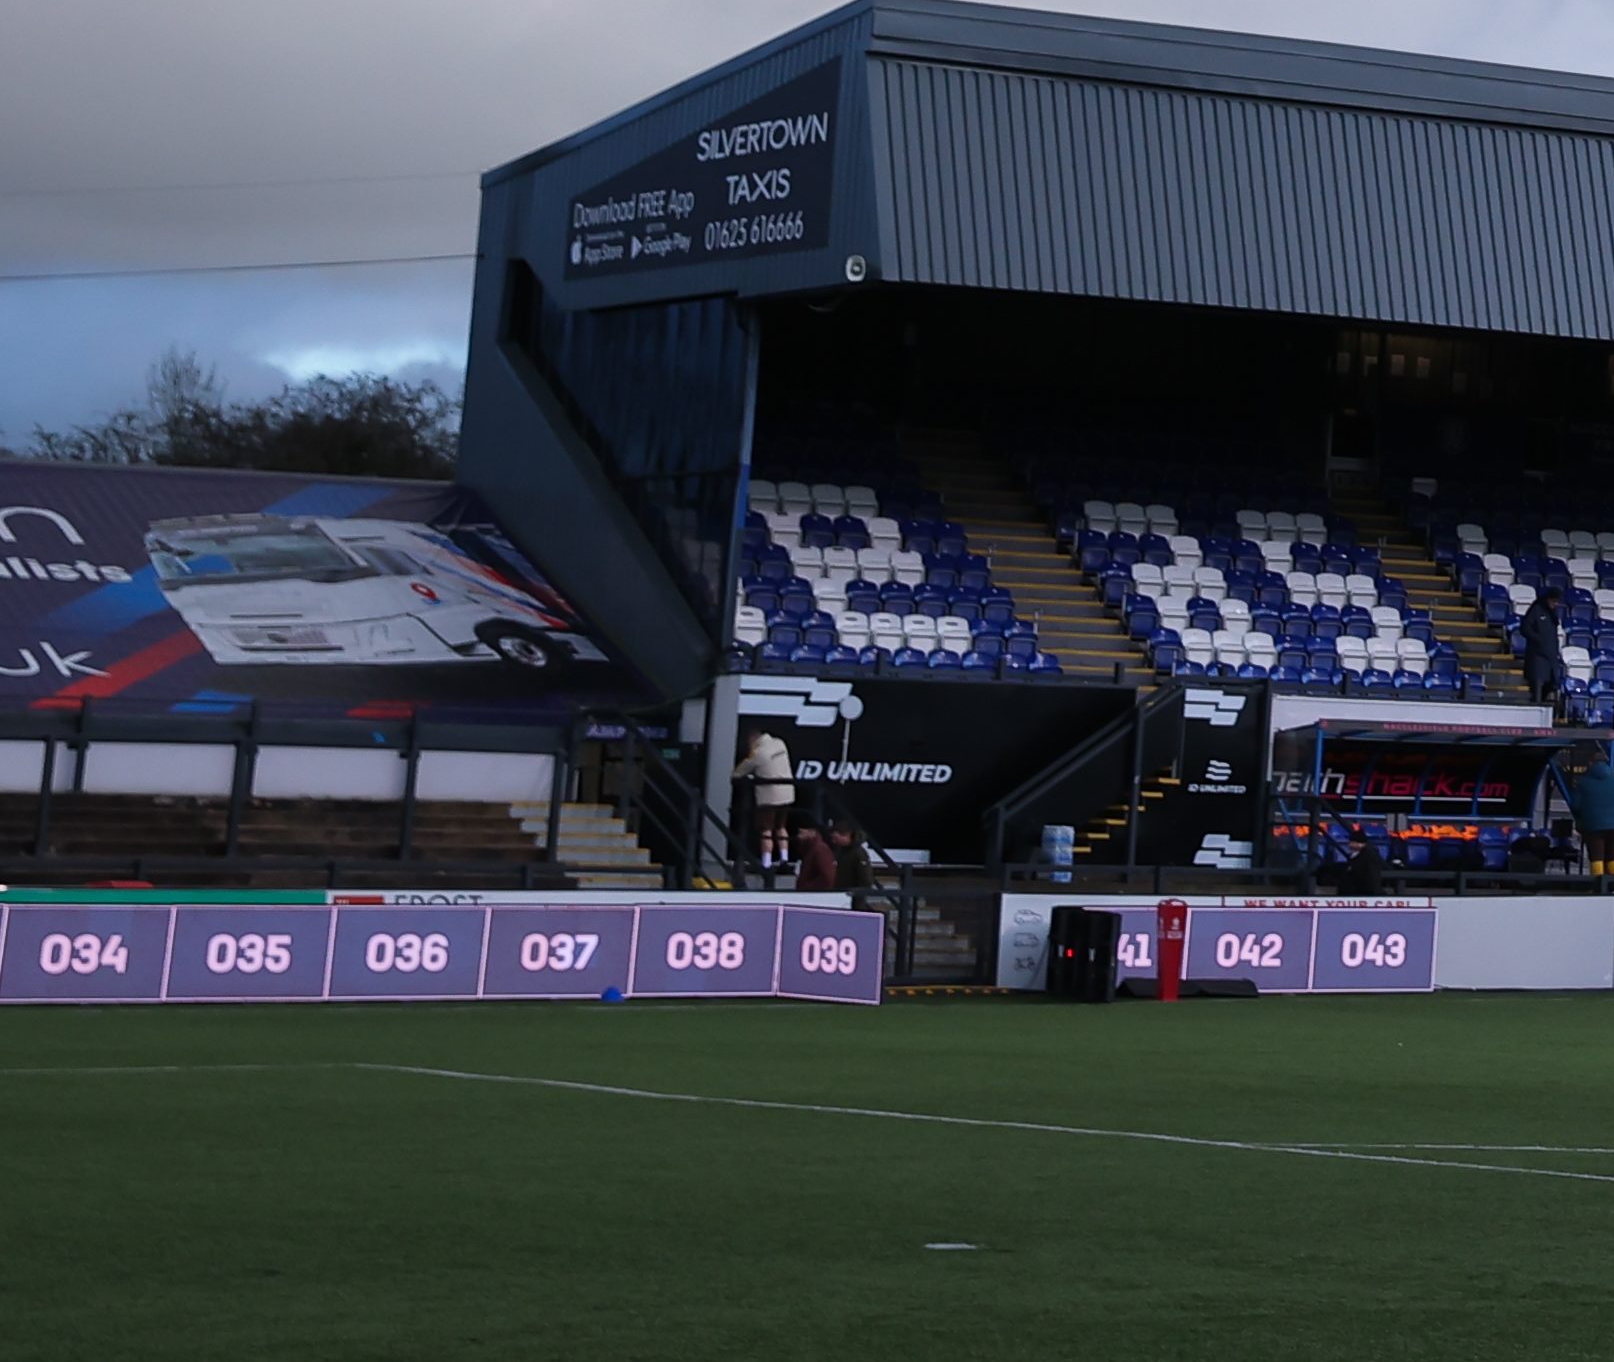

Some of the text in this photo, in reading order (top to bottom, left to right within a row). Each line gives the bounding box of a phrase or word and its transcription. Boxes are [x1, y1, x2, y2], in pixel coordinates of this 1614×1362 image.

[697, 112, 828, 161] SILVERTOWN
[726, 168, 790, 205] TAXIS
[574, 189, 695, 228] Download FREE App
[705, 210, 804, 250] 01625 616666
[795, 760, 952, 783] ID UNLIMITED
[40, 933, 128, 974] 034
[206, 933, 292, 973] 035
[366, 933, 449, 972] 036
[521, 933, 599, 971] 037
[667, 932, 744, 969] 038
[801, 935, 857, 975] 039
[1216, 933, 1283, 967] 042
[1342, 933, 1406, 967] 043
